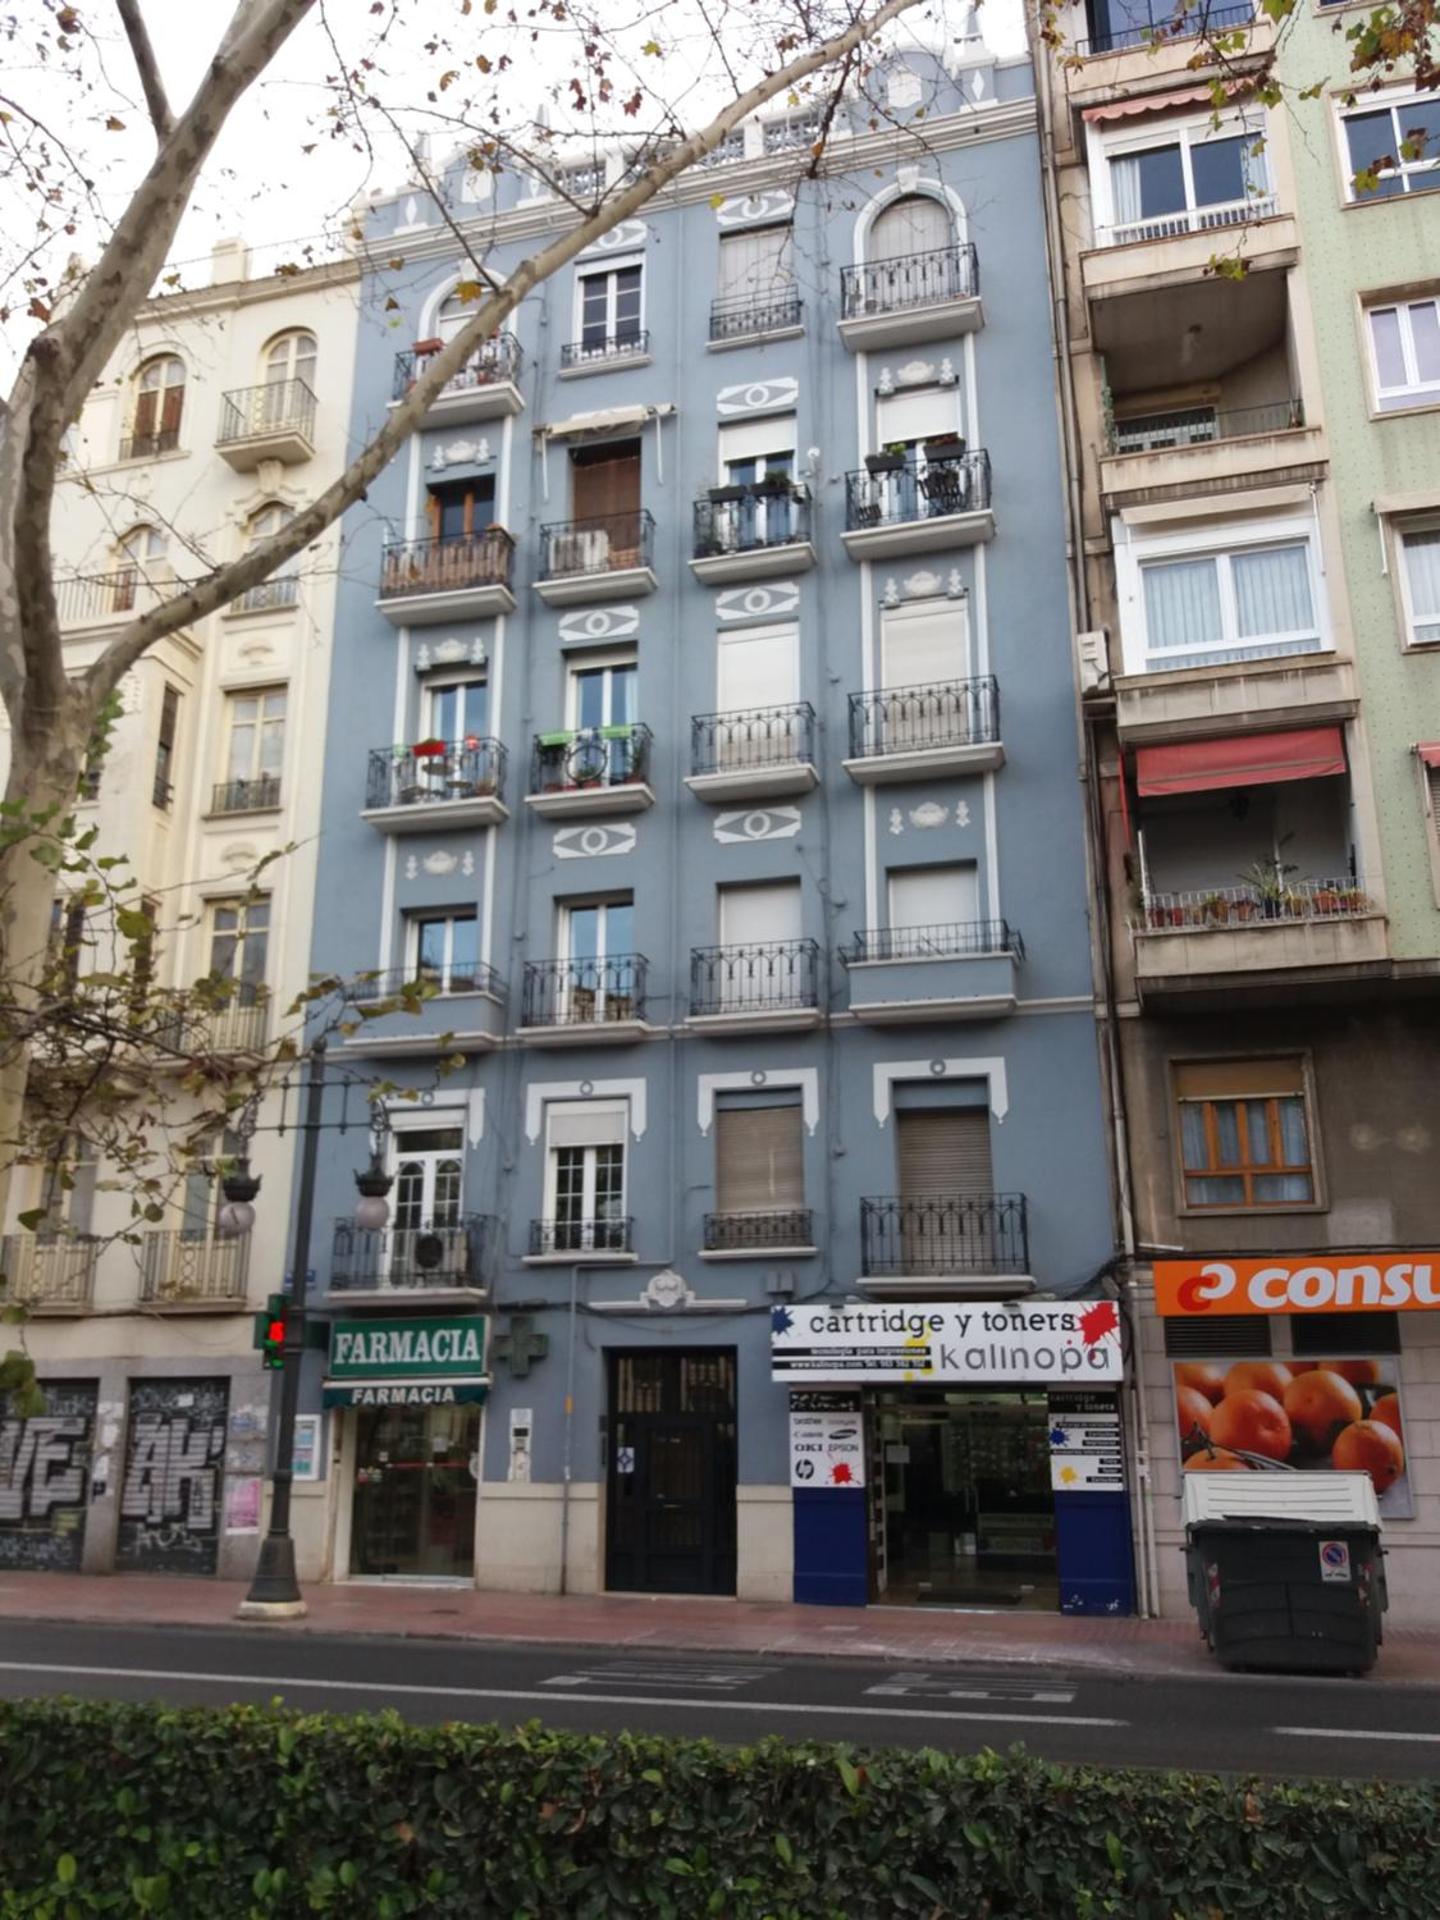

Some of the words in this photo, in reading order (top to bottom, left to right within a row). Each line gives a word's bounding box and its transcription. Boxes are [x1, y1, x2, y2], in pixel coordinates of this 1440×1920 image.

[809, 1309, 944, 1338] cartridge
[955, 1313, 972, 1337] y
[982, 1310, 1075, 1332] toners
[333, 1328, 481, 1364] FARMACIA
[940, 1344, 1109, 1373] kalinopa
[352, 1387, 456, 1404] FARMACIA
[794, 1443, 823, 1452] OKI
[828, 1443, 859, 1452] EPSON
